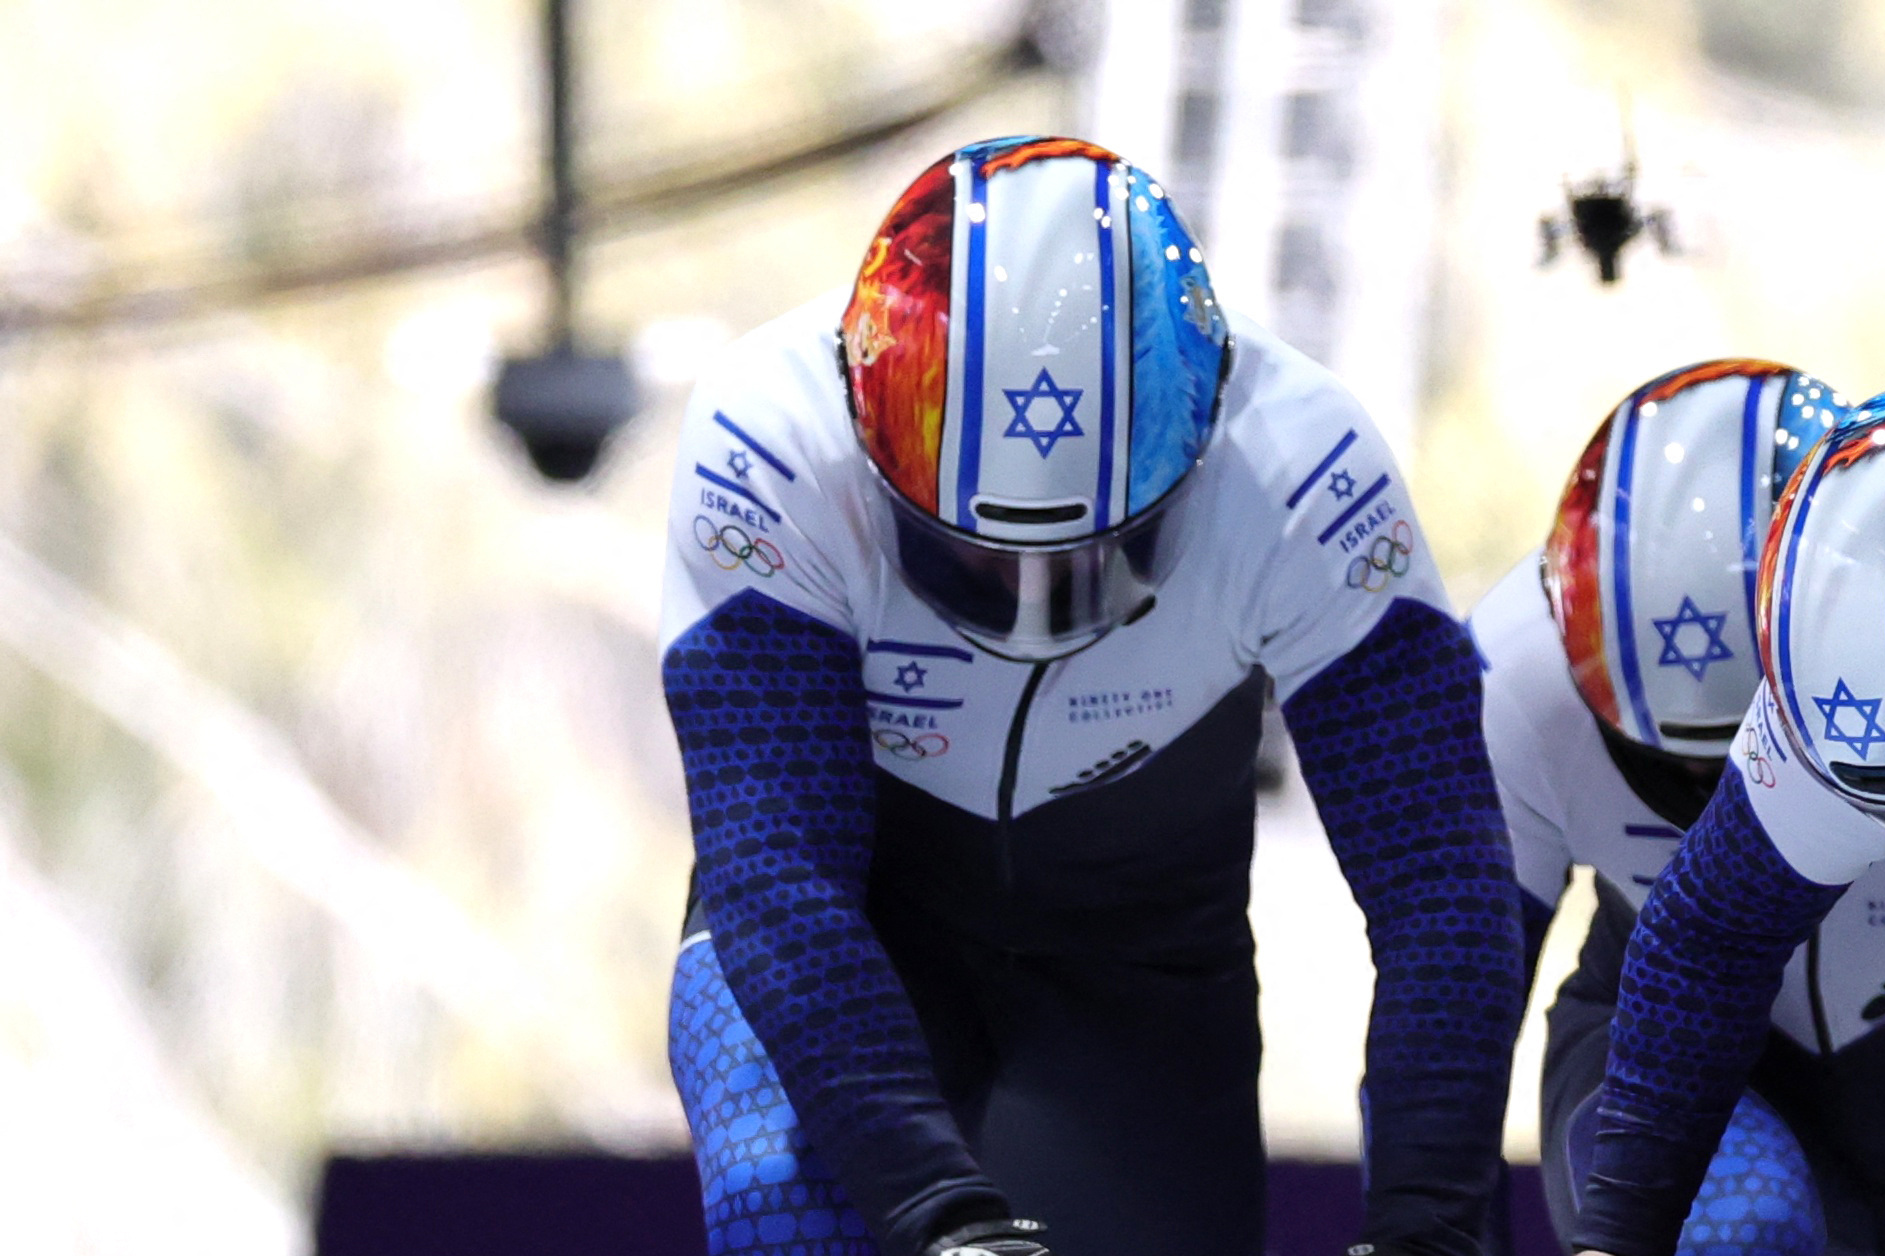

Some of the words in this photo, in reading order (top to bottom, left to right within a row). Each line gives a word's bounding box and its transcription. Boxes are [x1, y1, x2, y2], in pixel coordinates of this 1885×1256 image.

[700, 487, 770, 534] ISRAEL
[1339, 500, 1396, 554] ISRAEL
[868, 706, 939, 730] SRAEL
